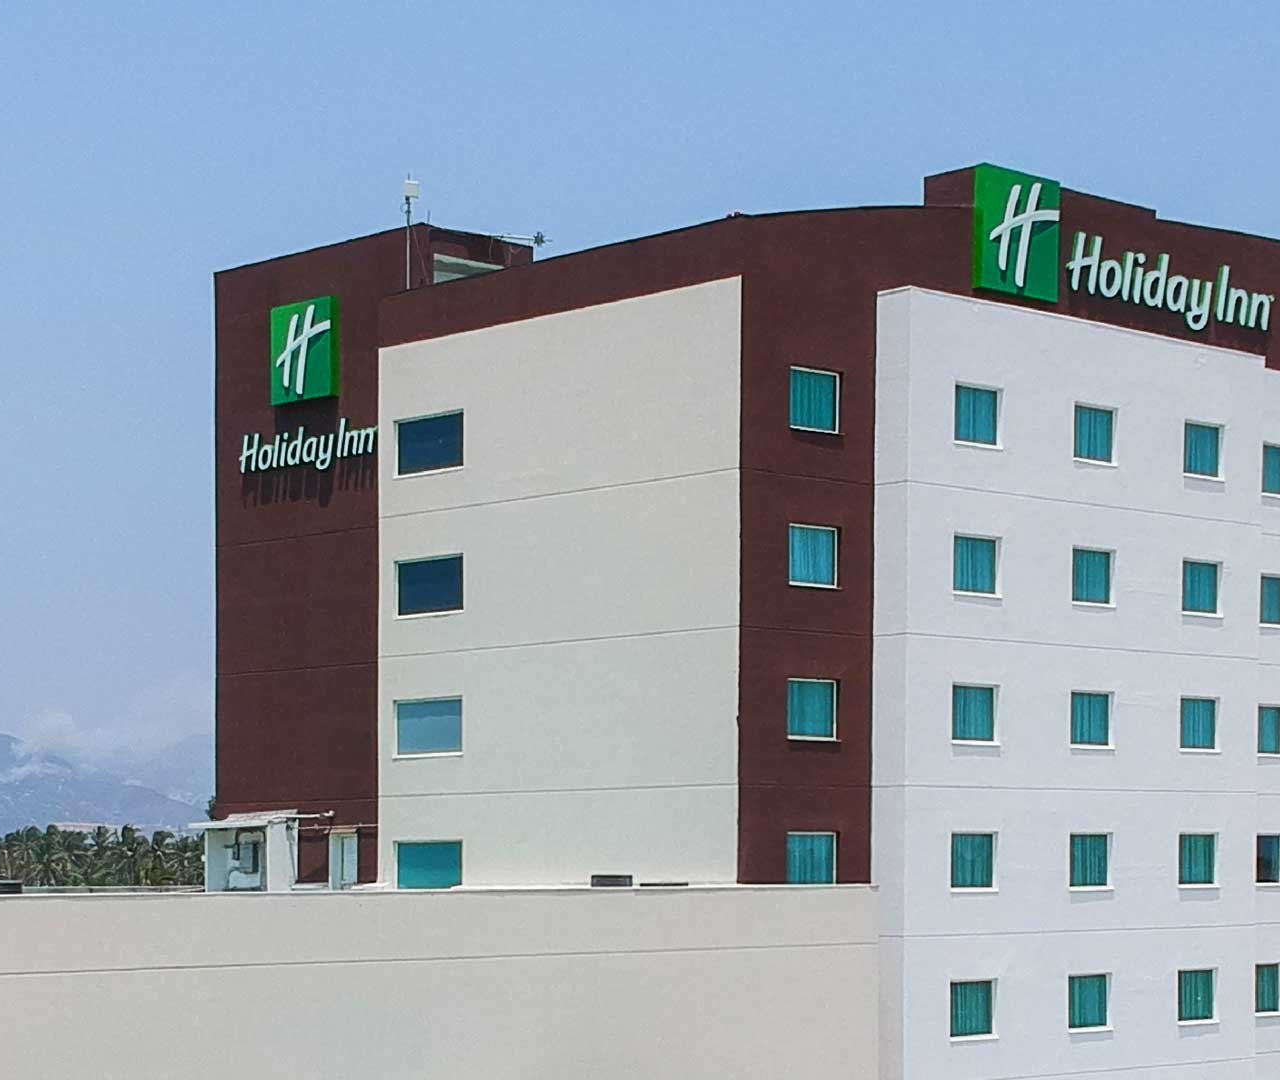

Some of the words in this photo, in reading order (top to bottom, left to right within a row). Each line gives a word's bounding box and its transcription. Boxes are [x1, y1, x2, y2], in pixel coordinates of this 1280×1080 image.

[989, 182, 1060, 288] H
[1066, 231, 1213, 331] Holiday
[1214, 264, 1271, 331] Inn
[275, 304, 332, 395] H
[238, 426, 334, 474] Holiday
[336, 417, 375, 458] Inn
